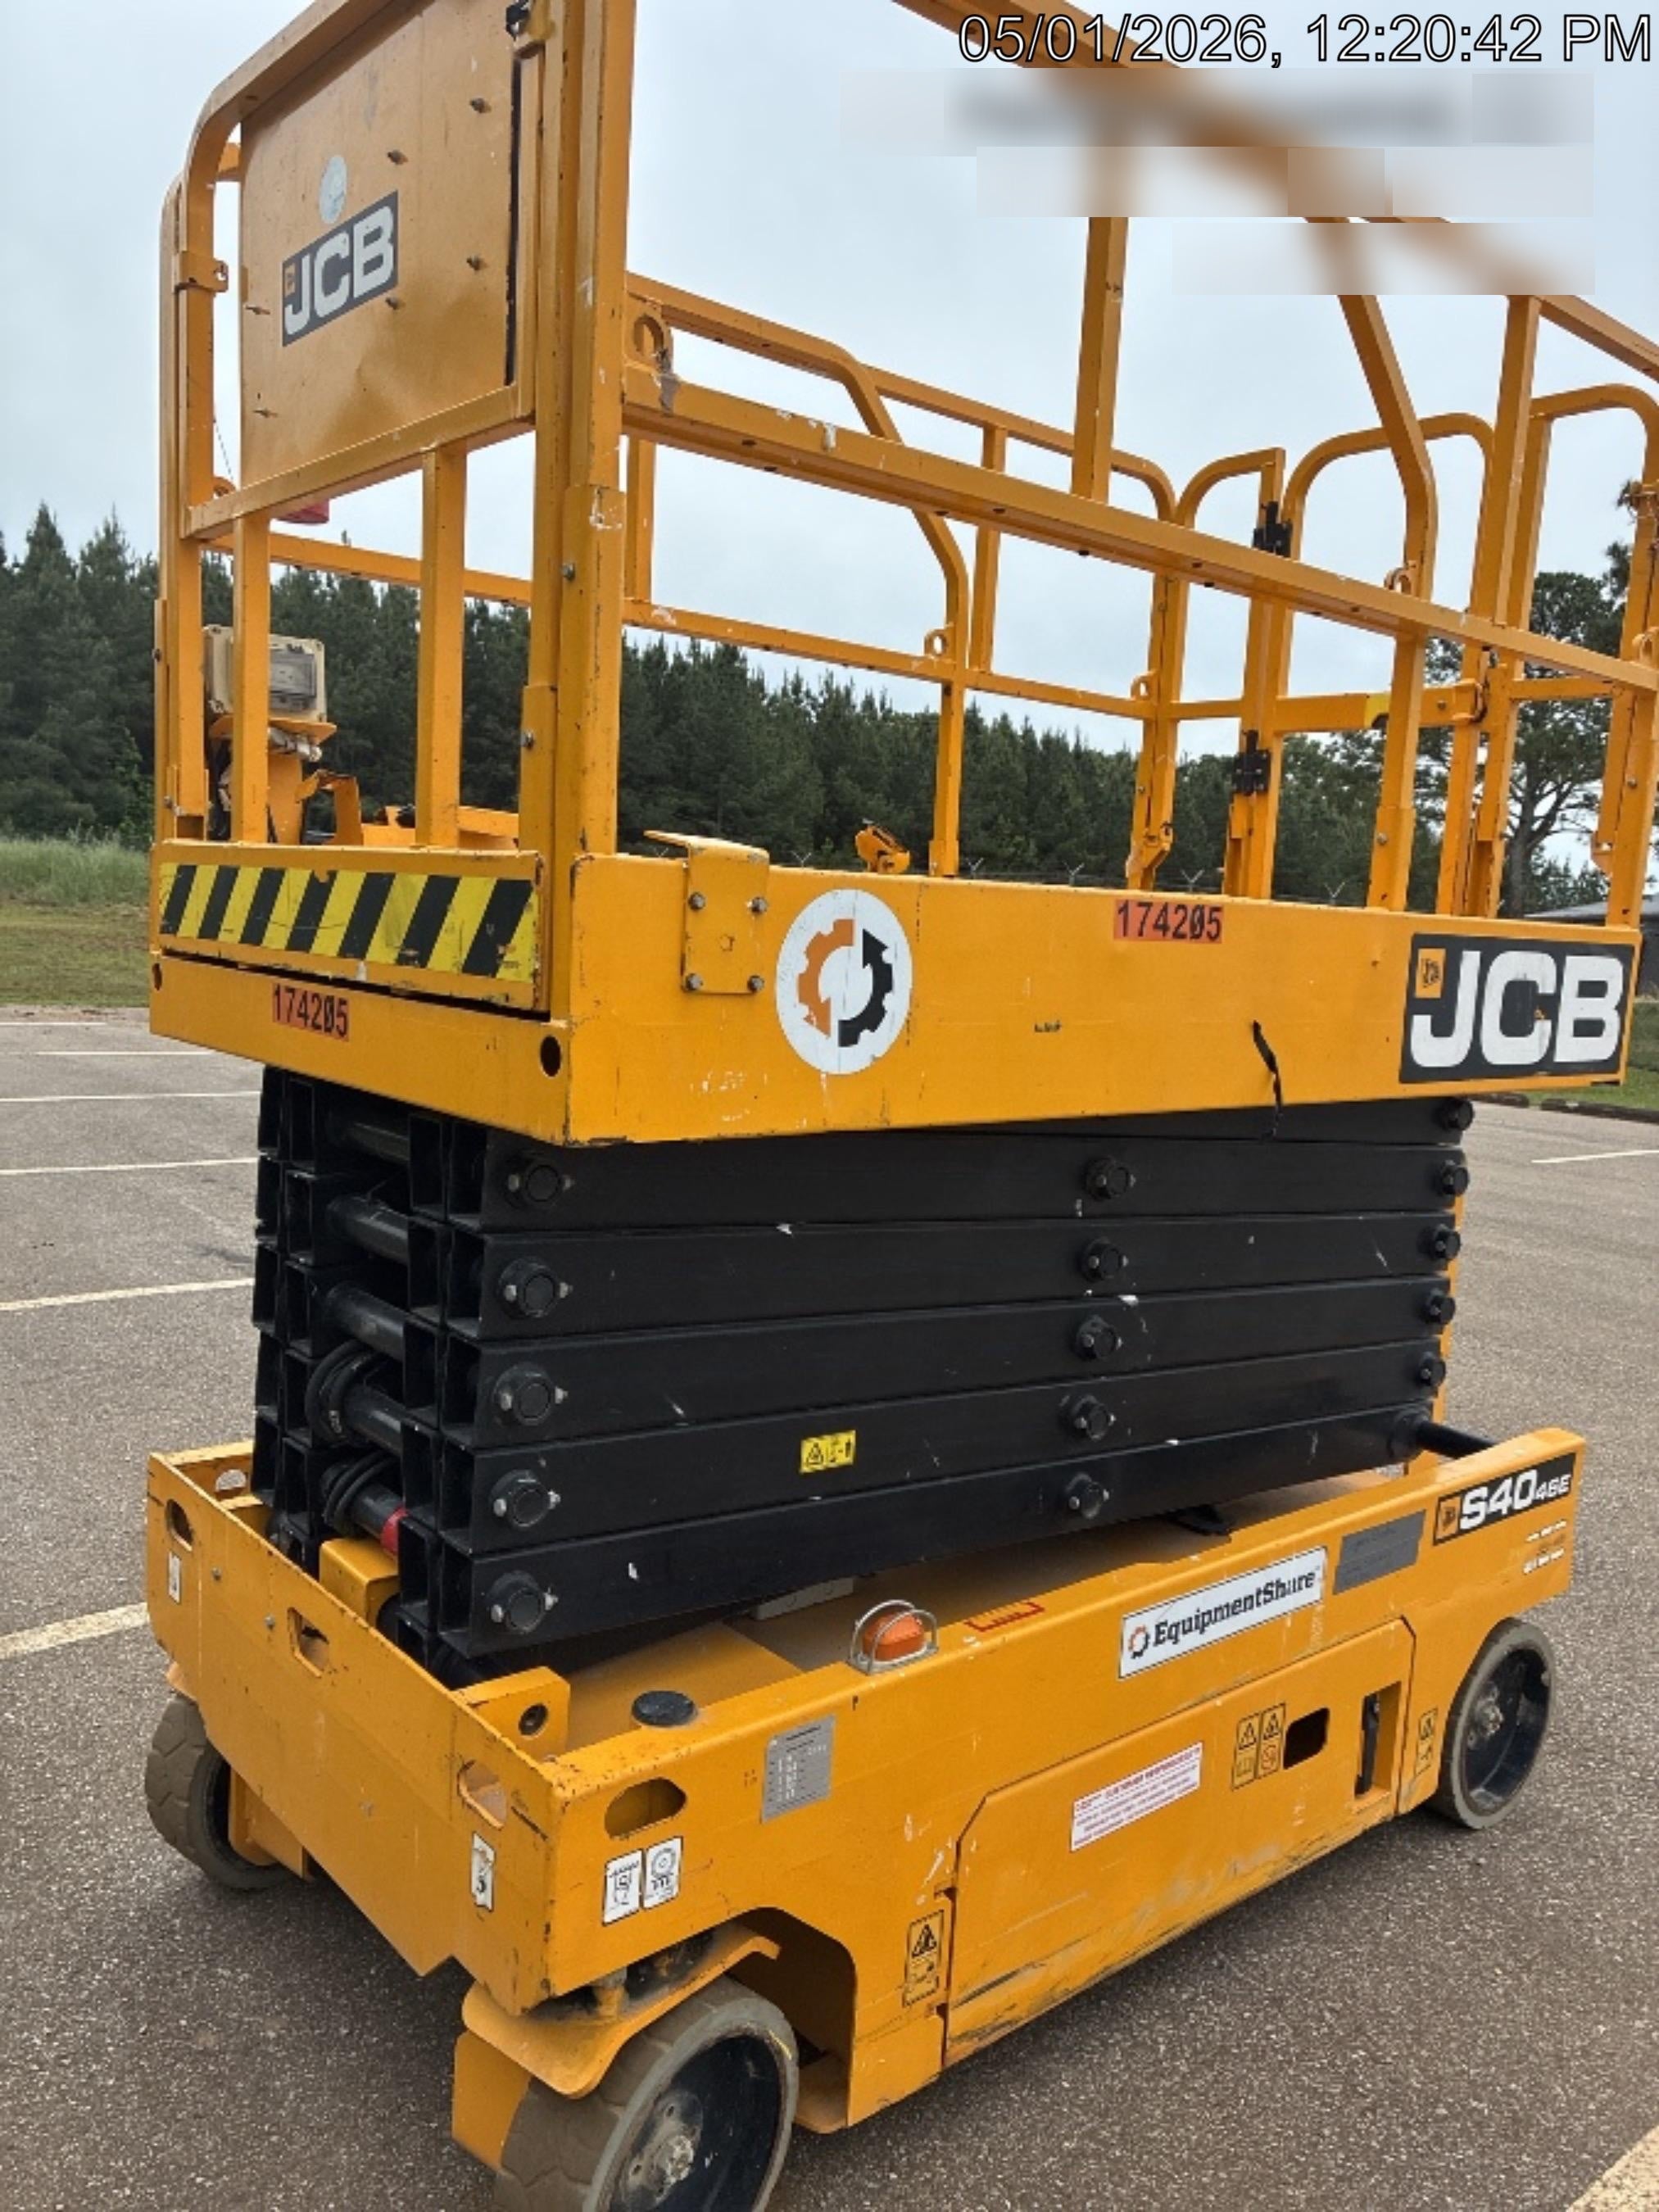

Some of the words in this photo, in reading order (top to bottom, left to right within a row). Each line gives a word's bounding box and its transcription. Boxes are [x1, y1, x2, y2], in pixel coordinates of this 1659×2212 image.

[284, 206, 394, 335] JCB
[1117, 899, 1223, 942] 174205
[274, 983, 348, 1038] 174205
[1410, 950, 1625, 1067] JCB
